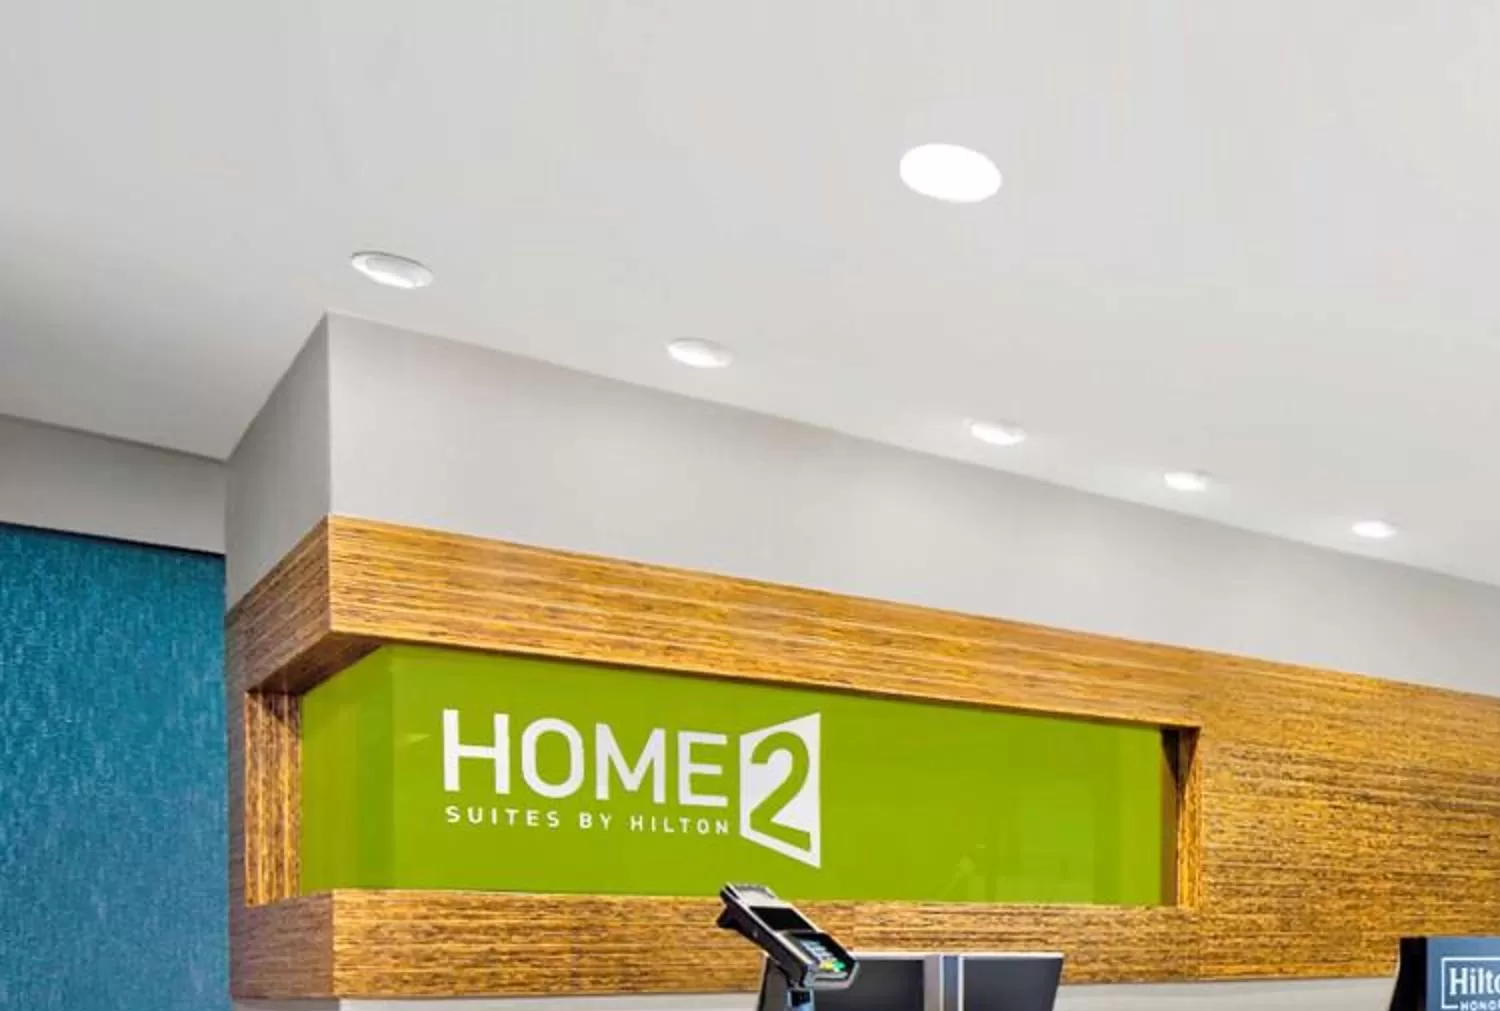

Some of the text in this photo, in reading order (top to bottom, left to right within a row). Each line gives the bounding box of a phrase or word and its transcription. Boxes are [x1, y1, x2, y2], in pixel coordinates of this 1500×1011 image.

[445, 805, 729, 835] SUITES BY HILTON
